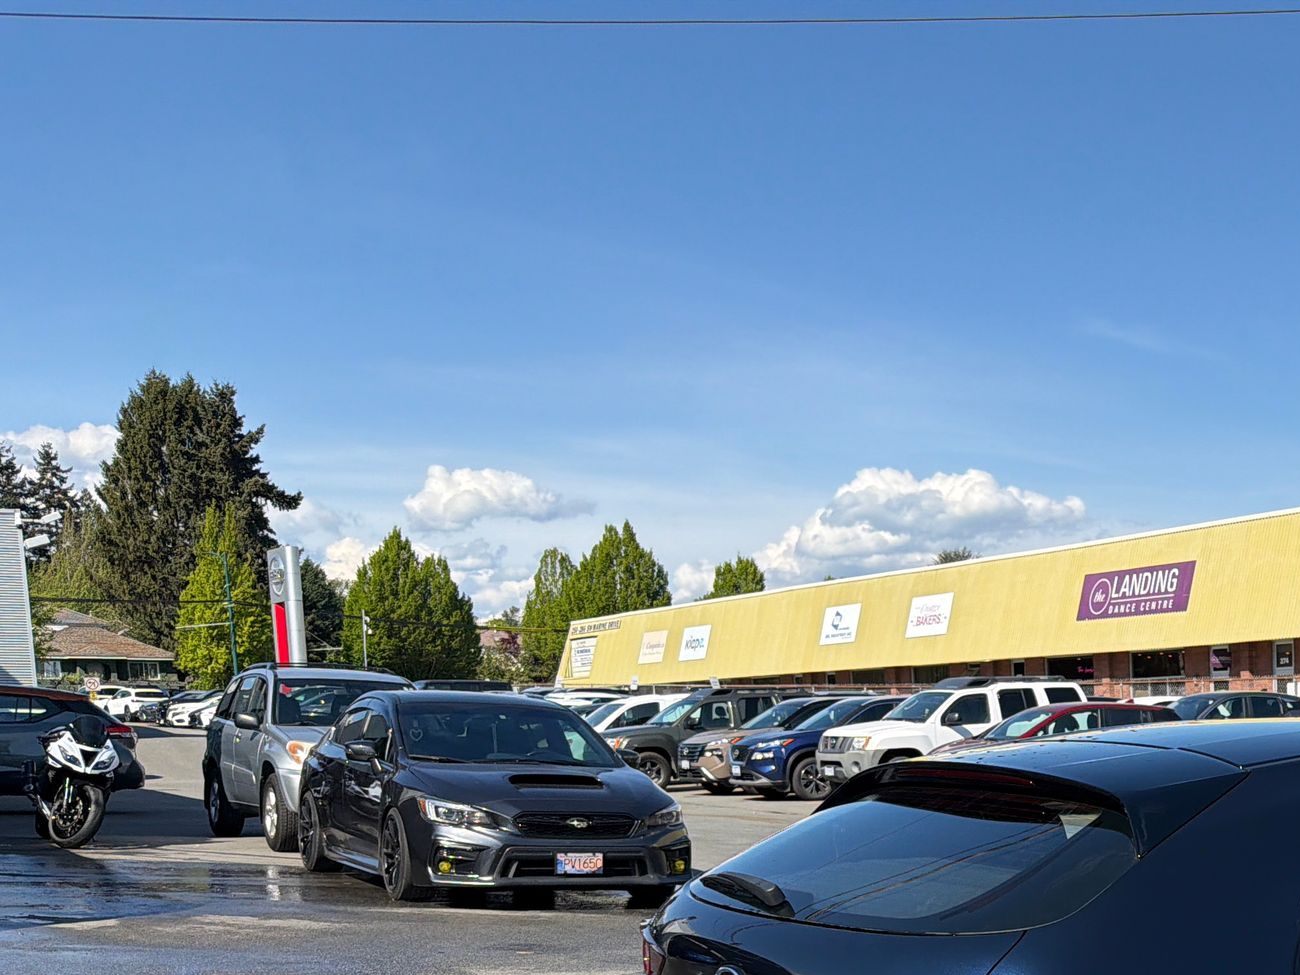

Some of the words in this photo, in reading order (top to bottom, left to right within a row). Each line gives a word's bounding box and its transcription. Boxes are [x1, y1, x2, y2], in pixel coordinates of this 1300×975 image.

[1093, 588, 1106, 603] the
[1111, 567, 1179, 598] LANDING
[1107, 602, 1137, 615] DANCE
[1140, 599, 1174, 612] CENTRE
